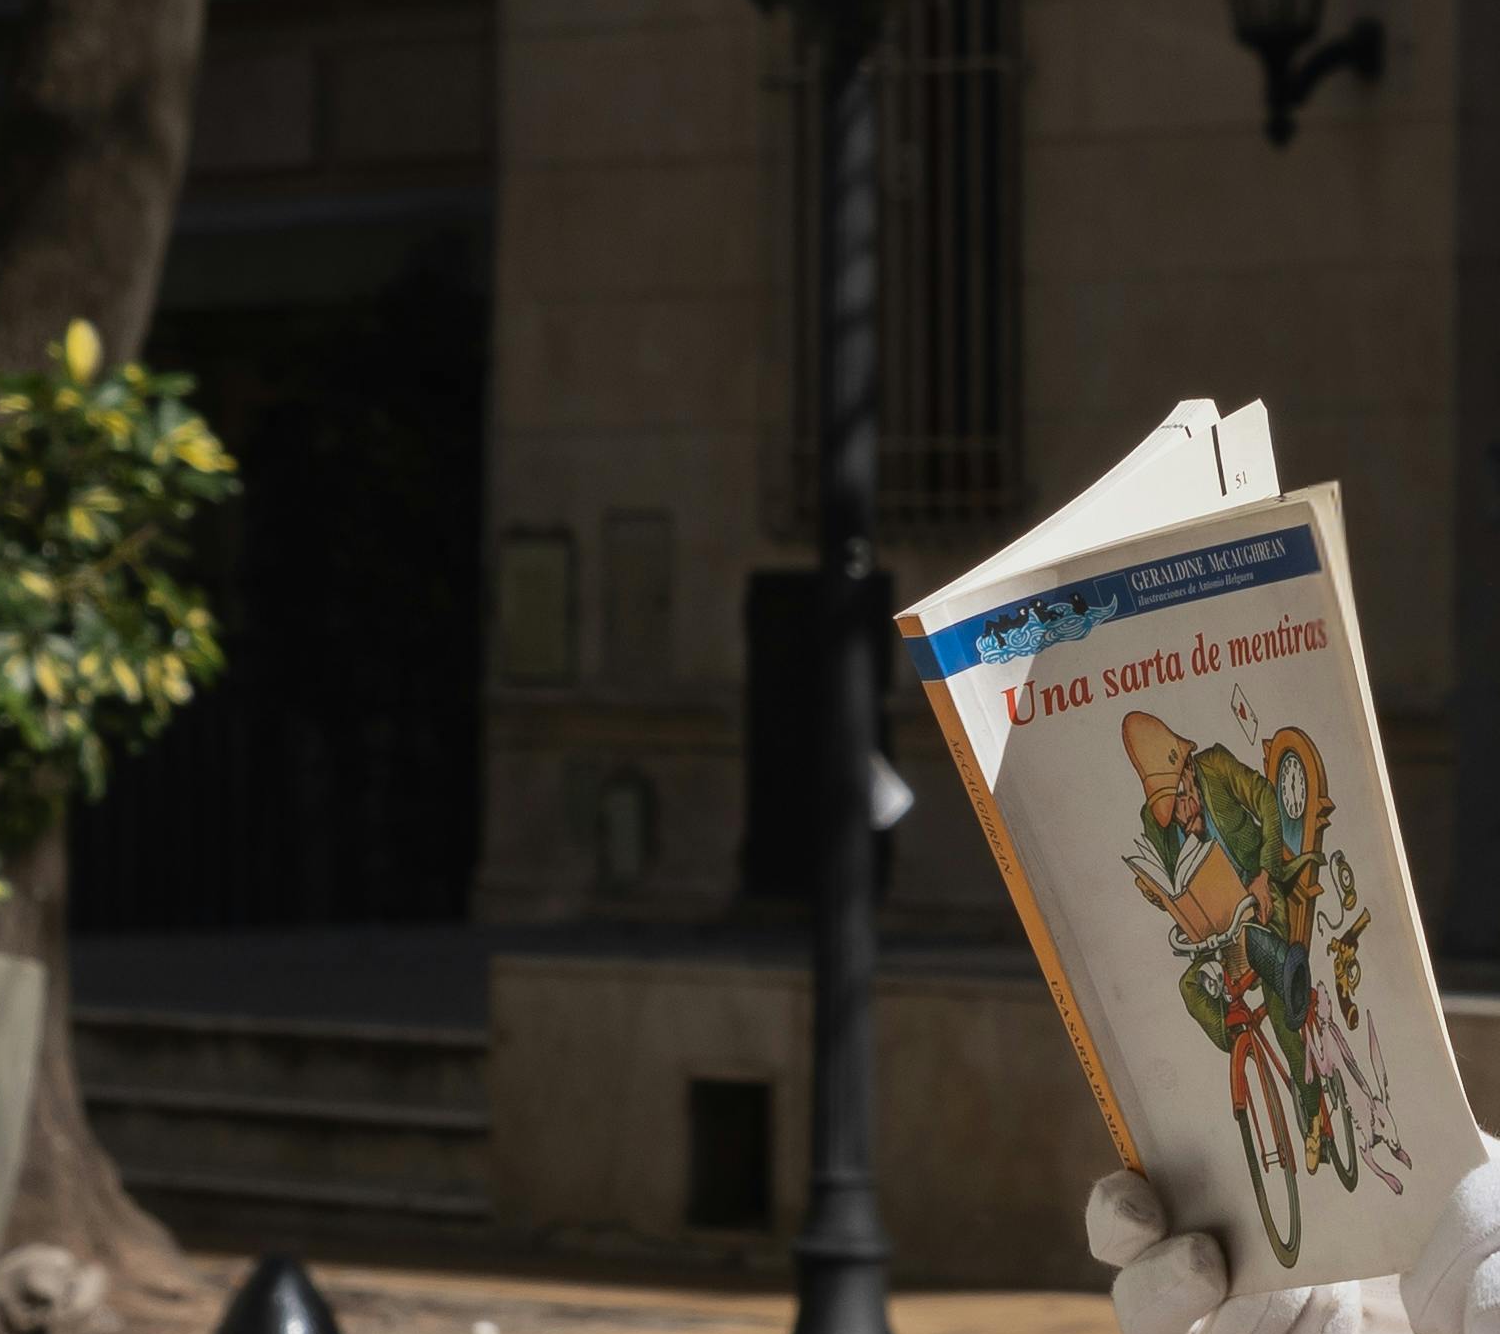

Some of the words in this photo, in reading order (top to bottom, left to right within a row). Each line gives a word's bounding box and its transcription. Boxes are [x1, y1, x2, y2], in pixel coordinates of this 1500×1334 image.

[1235, 470, 1247, 489] 51
[1131, 555, 1204, 591] GERALDINE
[1209, 537, 1286, 574] McCAUGHREAN
[1138, 587, 1187, 607] ilustraciones
[1188, 583, 1197, 595] de
[1198, 575, 1224, 593] Antonio
[1001, 679, 1093, 726] Una
[1102, 648, 1185, 698] sarta
[1191, 632, 1221, 677] de
[1228, 614, 1328, 668] mentiras
[1105, 1112, 1131, 1167] MENT
